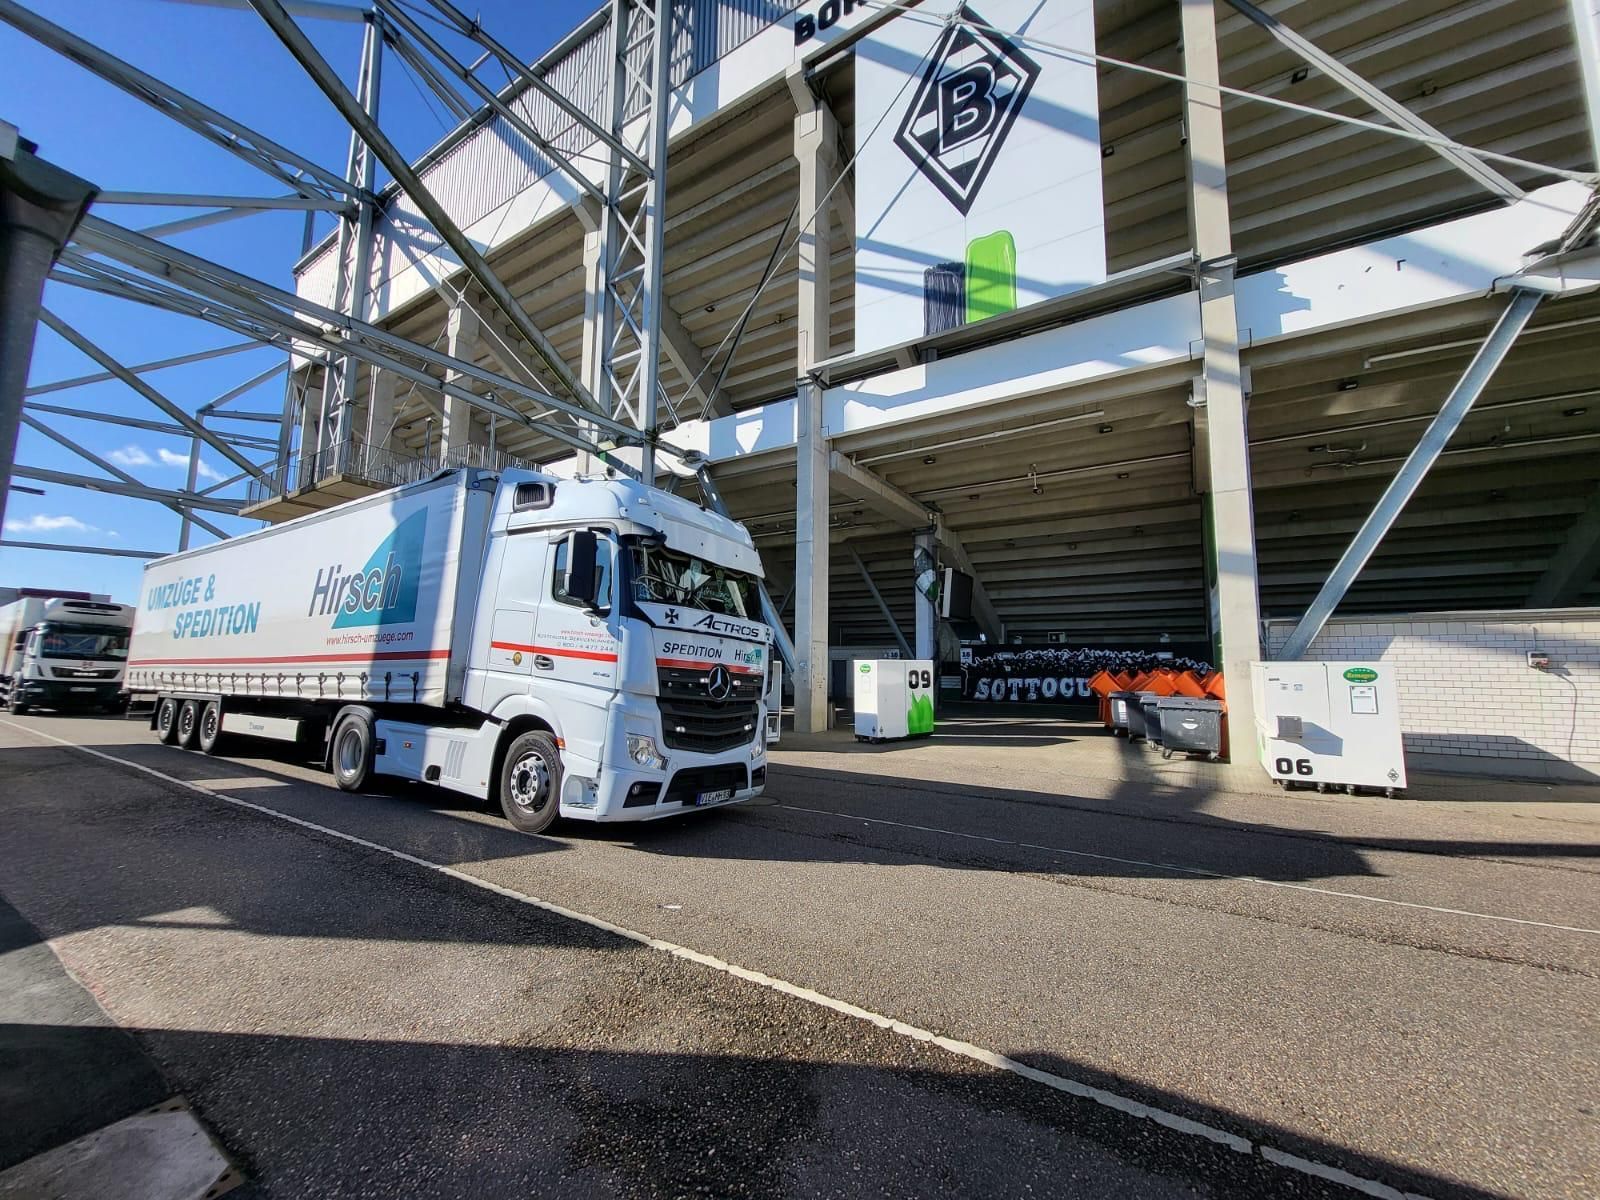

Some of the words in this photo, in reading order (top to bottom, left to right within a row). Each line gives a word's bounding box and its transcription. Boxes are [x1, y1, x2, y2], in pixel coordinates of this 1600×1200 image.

[147, 576, 203, 611] UMZÜGE
[204, 573, 216, 602] &
[308, 551, 402, 617] Hirsch
[173, 601, 261, 639] SPEDITION
[326, 632, 414, 645] www.hirsch-umzuege.com
[662, 642, 722, 659] SPEDITION
[909, 669, 931, 689] 09
[1275, 757, 1314, 776] 06
